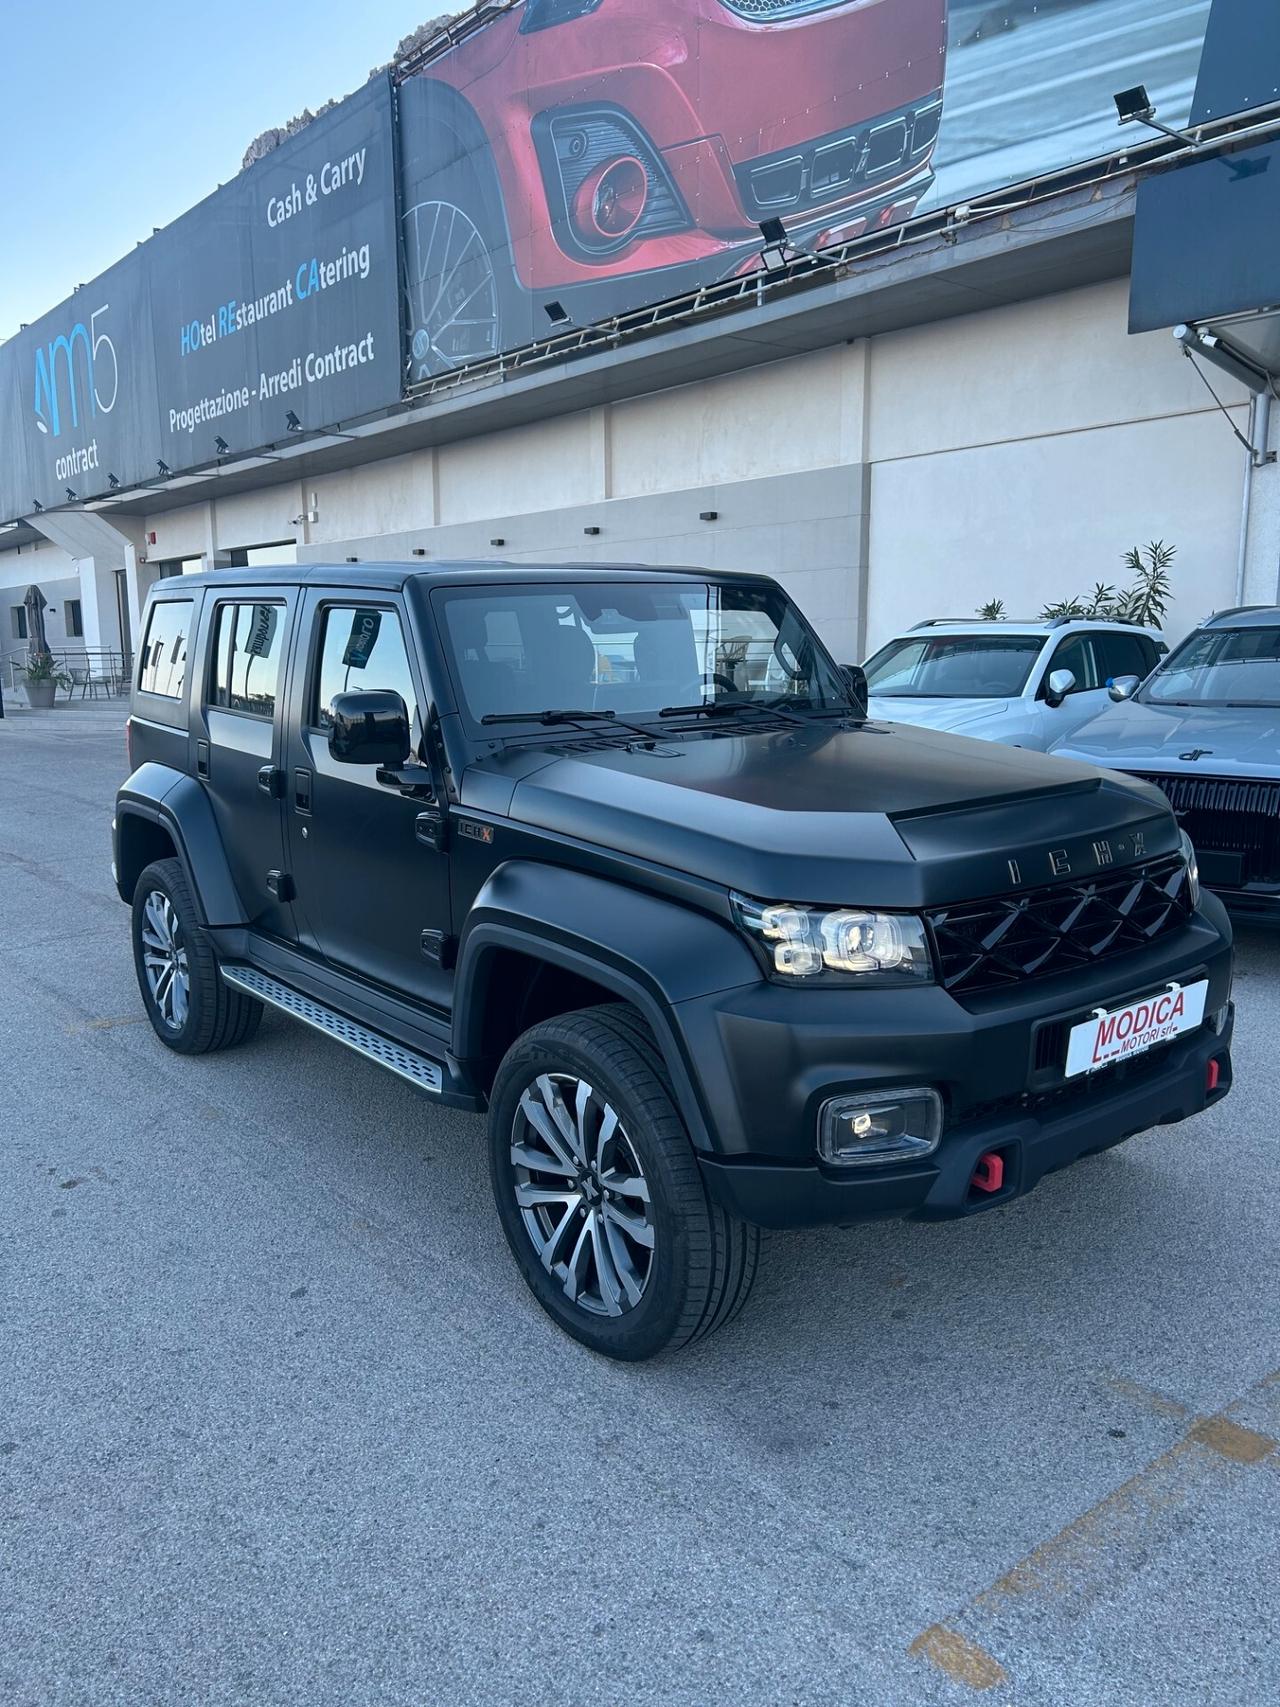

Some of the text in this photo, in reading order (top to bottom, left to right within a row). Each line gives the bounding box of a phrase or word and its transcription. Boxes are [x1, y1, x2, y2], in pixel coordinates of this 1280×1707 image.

[267, 148, 366, 228] Cash & Carry
[180, 243, 371, 357] HOtel REstaurant CAtering
[169, 386, 249, 434] Progettazione
[259, 358, 302, 401] Arredi
[304, 332, 375, 383] Contract
[55, 439, 99, 481] contract
[1094, 992, 1185, 1056] MODICA
[1120, 1030, 1161, 1053] MOTORI
